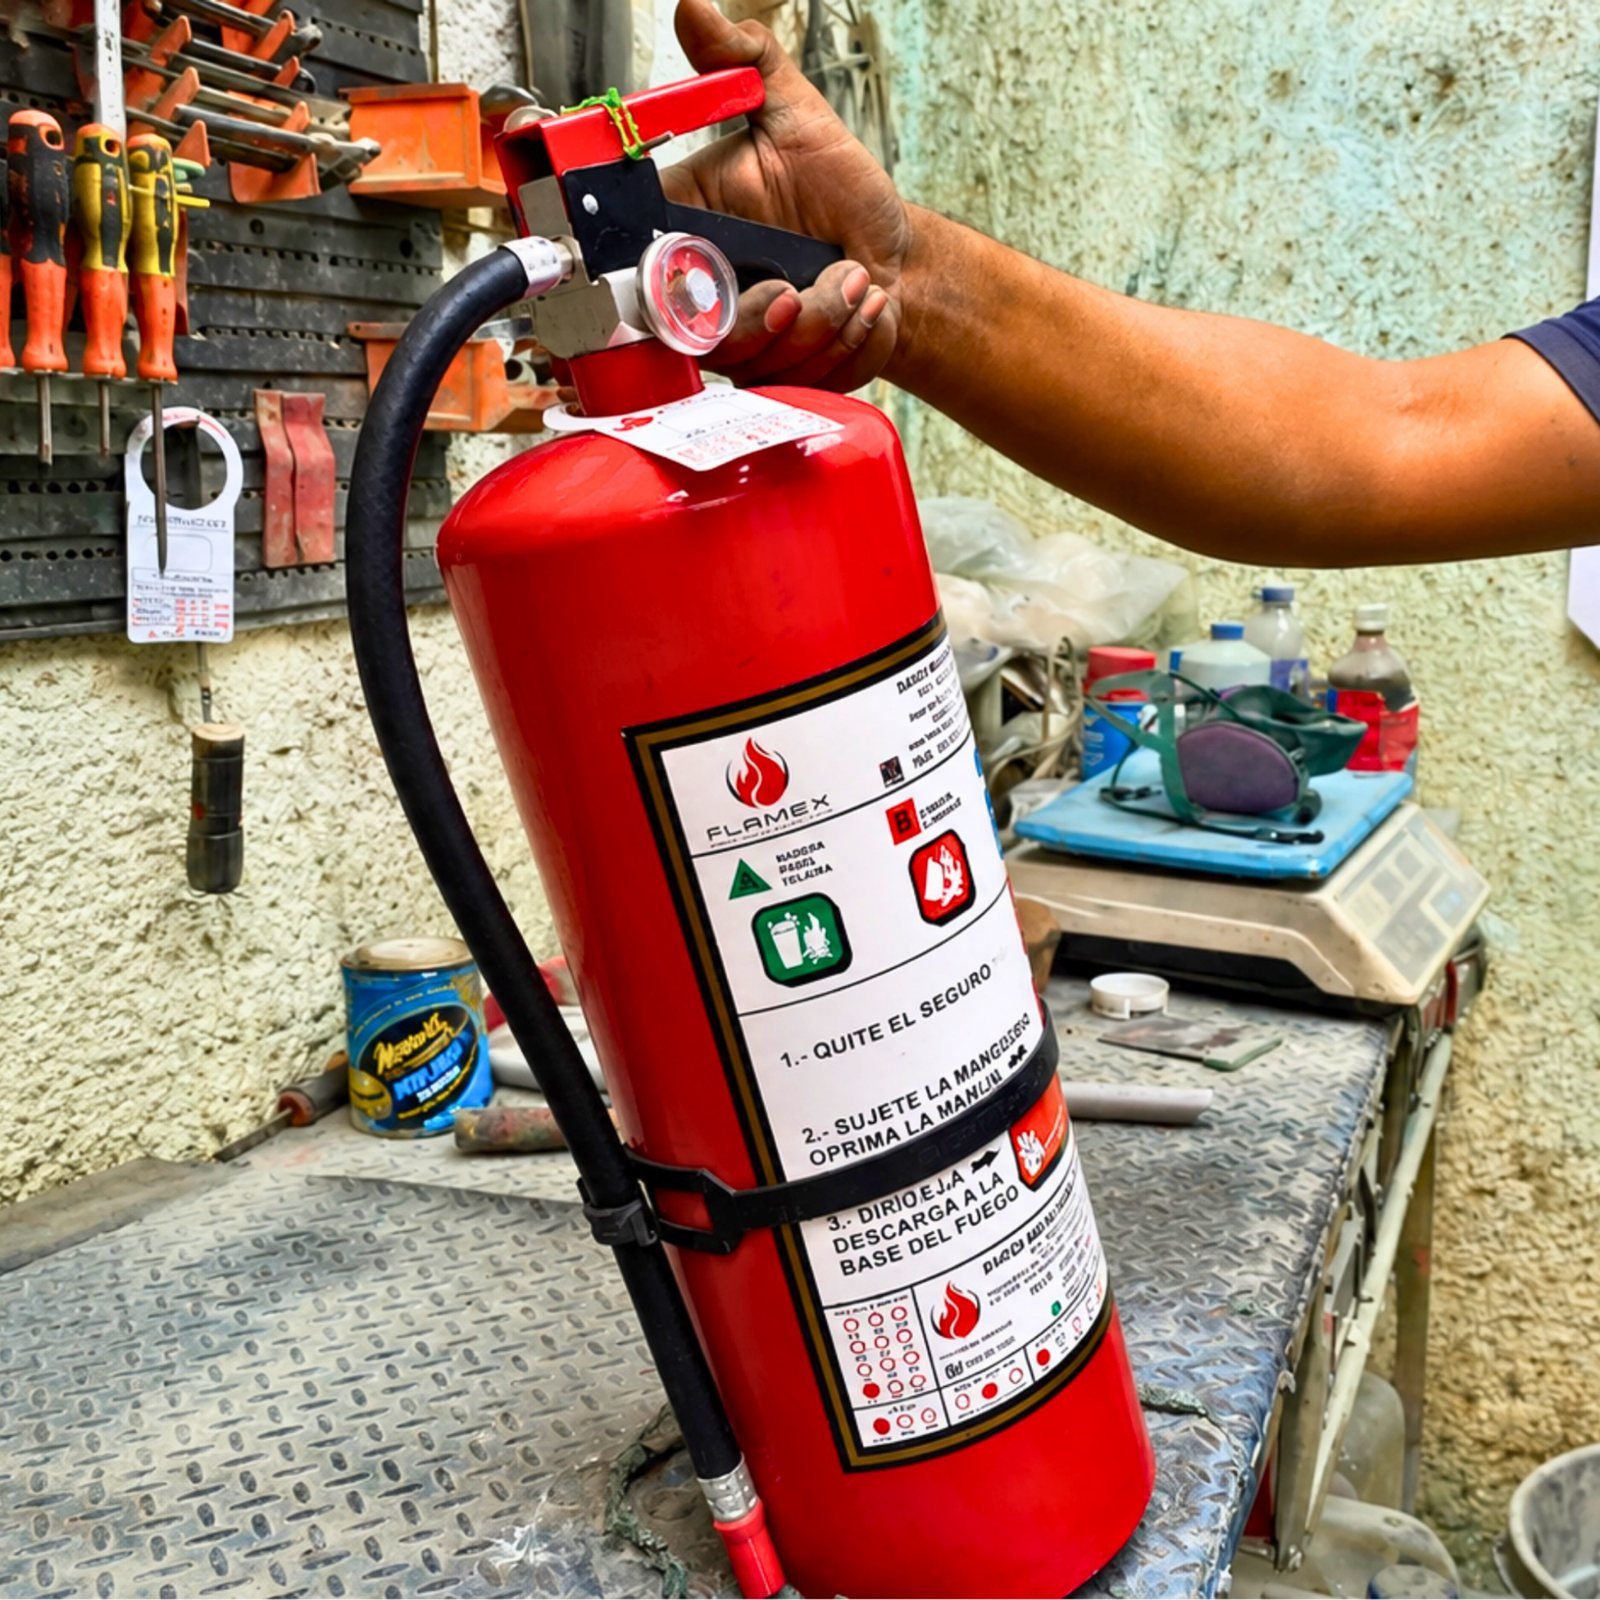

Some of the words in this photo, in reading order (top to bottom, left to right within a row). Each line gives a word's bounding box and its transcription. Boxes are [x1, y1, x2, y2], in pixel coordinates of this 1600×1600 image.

[706, 794, 830, 841] FLAMEX
[894, 809, 911, 834] B
[780, 1052, 808, 1069] 1.-
[813, 1023, 884, 1060] QUITE
[888, 1012, 916, 1034] EL
[920, 963, 992, 1018] SEGURO
[802, 1127, 829, 1144] 2.-
[834, 1091, 921, 1135] SUJETE
[925, 1077, 952, 1101] LA
[809, 1127, 901, 1166] OPRIMA
[905, 1112, 934, 1136] LA
[833, 1198, 960, 1254] DESCARGA
[964, 1188, 978, 1207] A
[978, 1172, 1004, 1195] LA
[840, 1244, 904, 1276] BASE
[908, 1228, 952, 1255] DEL
[955, 1185, 1019, 1234] FUEGO
